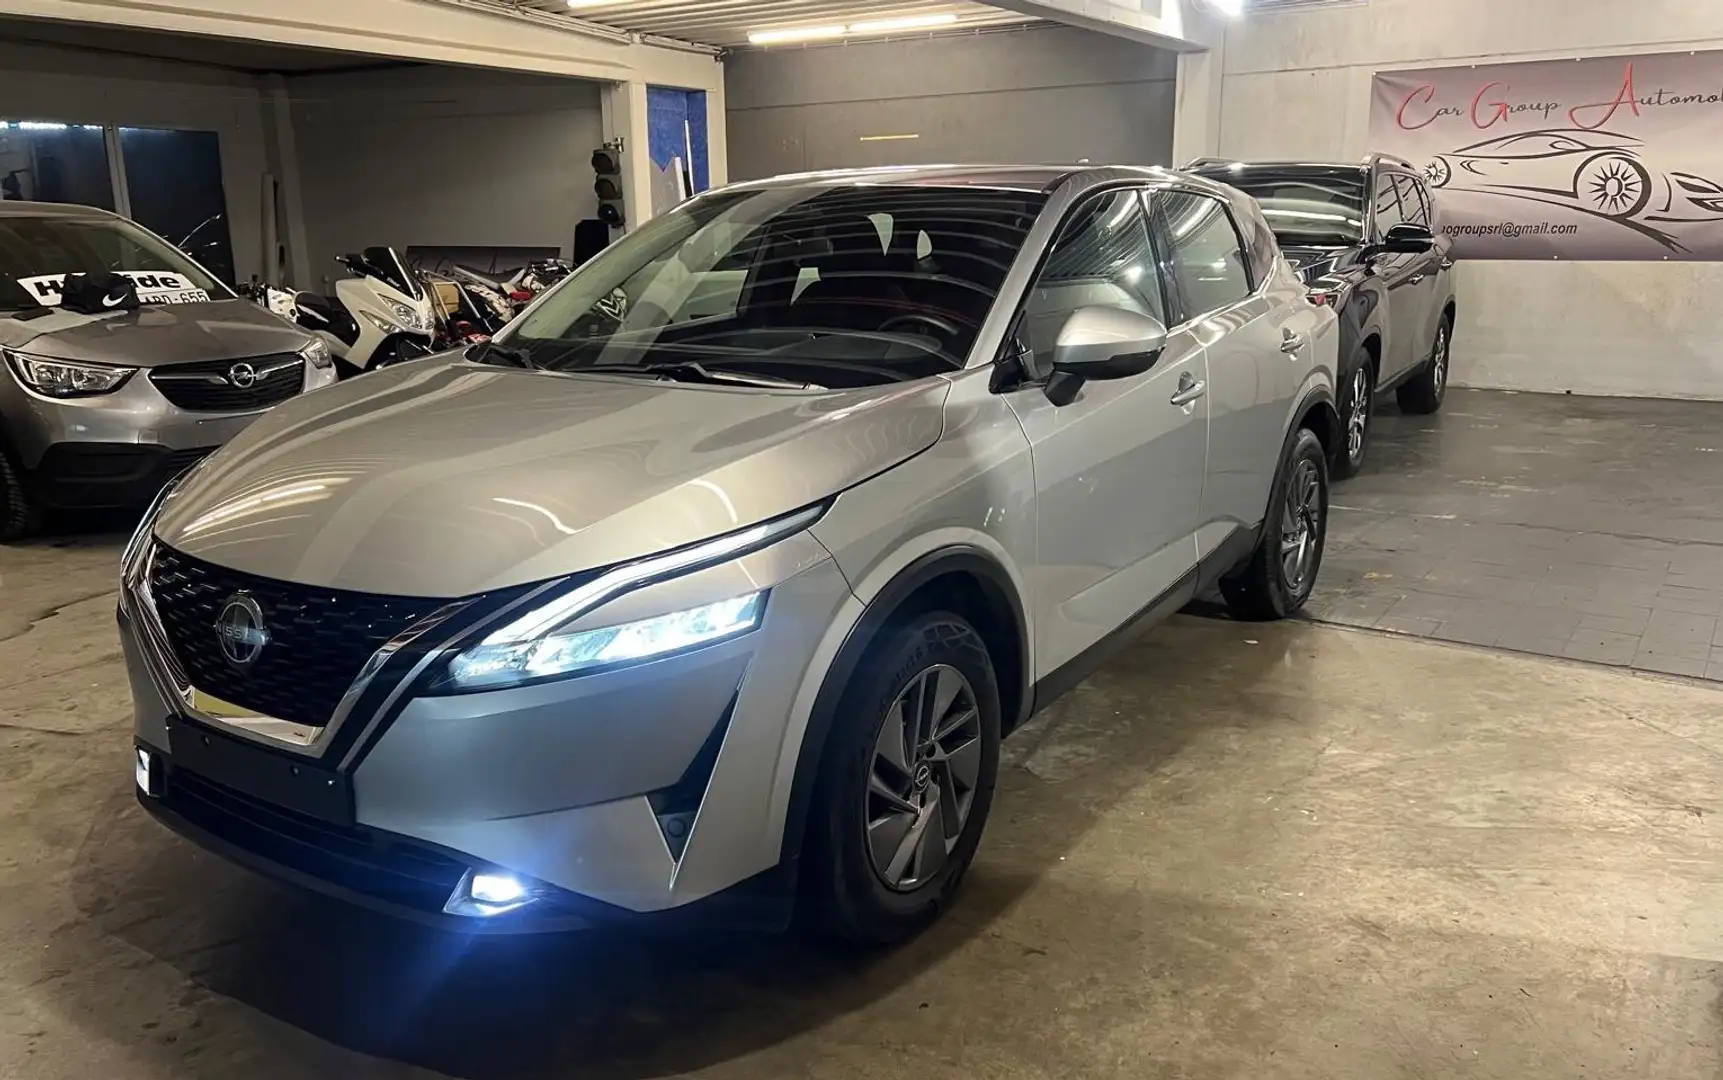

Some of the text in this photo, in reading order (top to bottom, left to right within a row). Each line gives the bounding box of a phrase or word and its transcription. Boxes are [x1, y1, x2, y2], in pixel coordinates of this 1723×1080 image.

[1397, 84, 1464, 130] Car
[1471, 82, 1561, 129] Group
[215, 620, 264, 644] NISS
